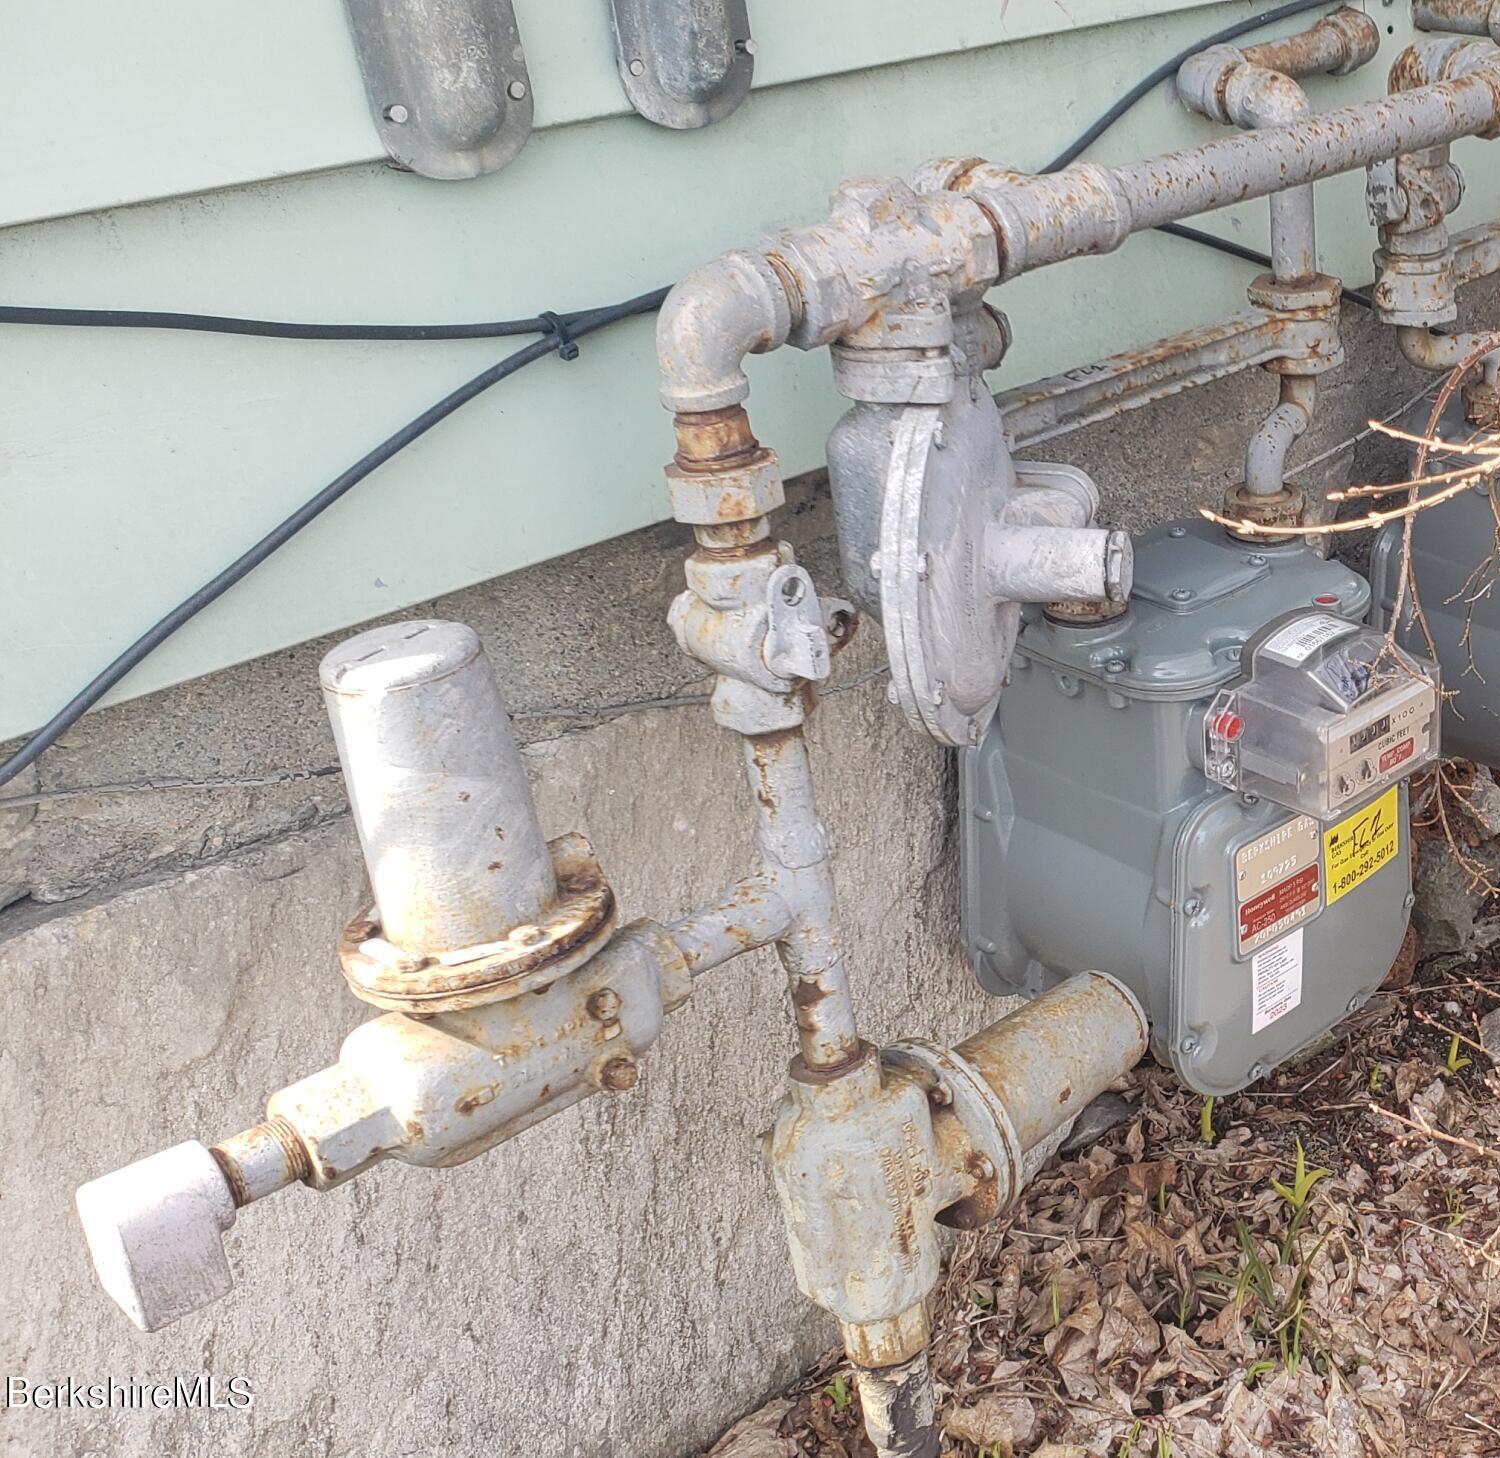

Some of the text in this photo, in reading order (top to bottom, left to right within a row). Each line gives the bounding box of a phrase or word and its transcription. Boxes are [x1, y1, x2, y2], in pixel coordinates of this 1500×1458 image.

[1333, 840, 1394, 894] 1-800-292-5012
[1245, 893, 1276, 916] Honeywell
[1251, 912, 1276, 934] AC-250
